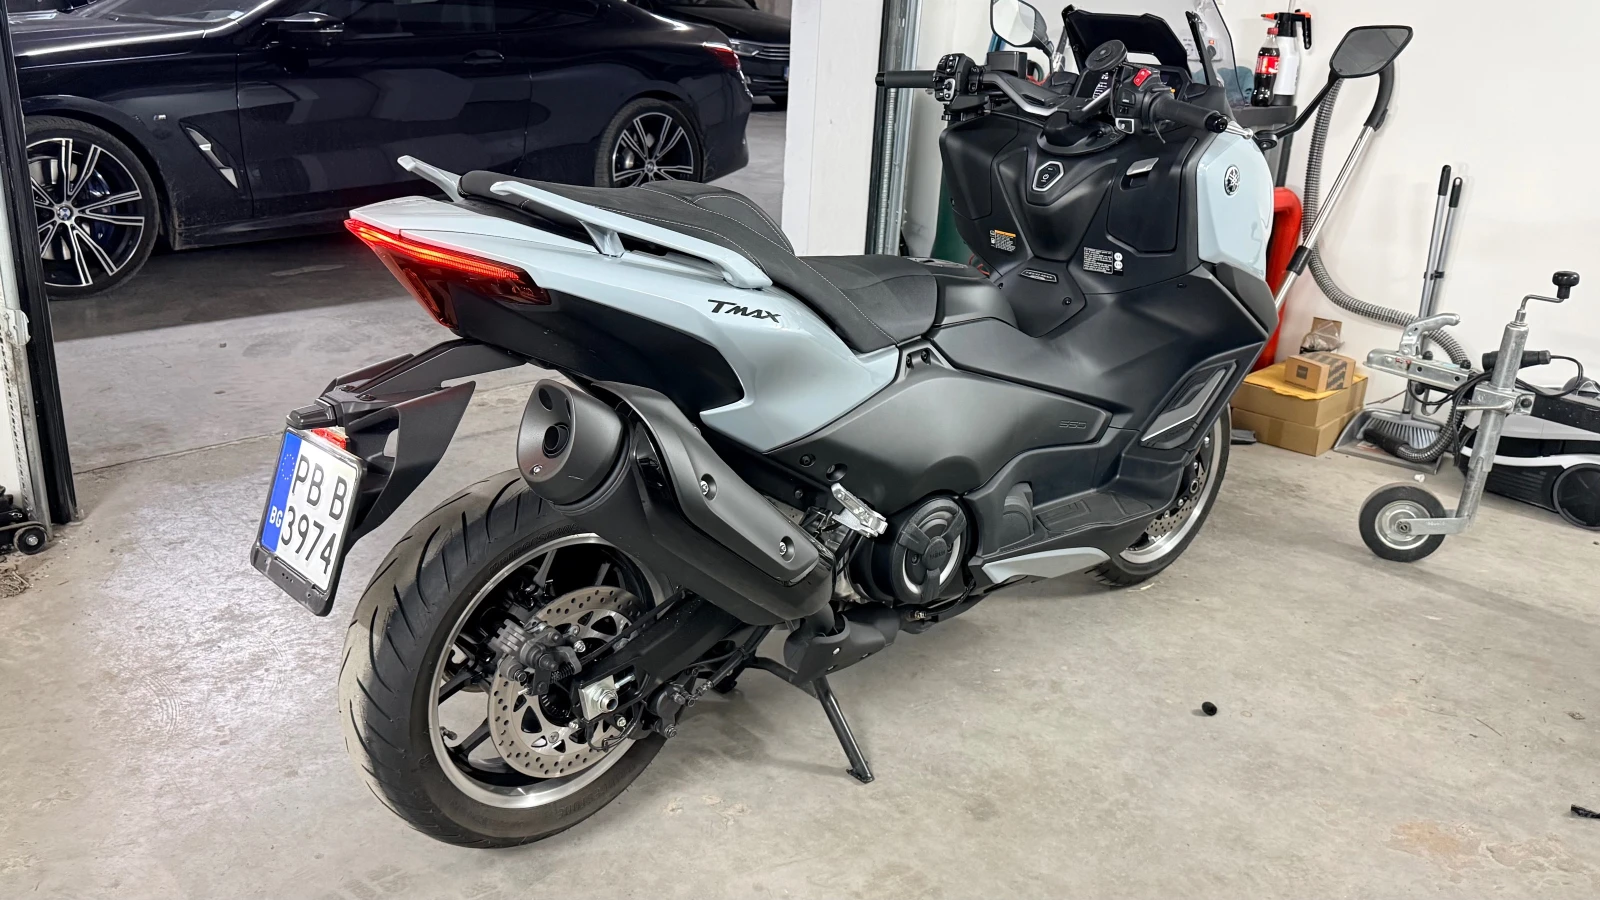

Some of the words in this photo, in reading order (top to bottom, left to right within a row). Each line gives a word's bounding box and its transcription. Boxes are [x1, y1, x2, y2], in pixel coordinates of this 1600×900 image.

[708, 299, 781, 323] TMAX
[292, 454, 324, 507] PB
[328, 475, 348, 521] B
[269, 506, 283, 528] BG
[281, 505, 337, 575] 3974
